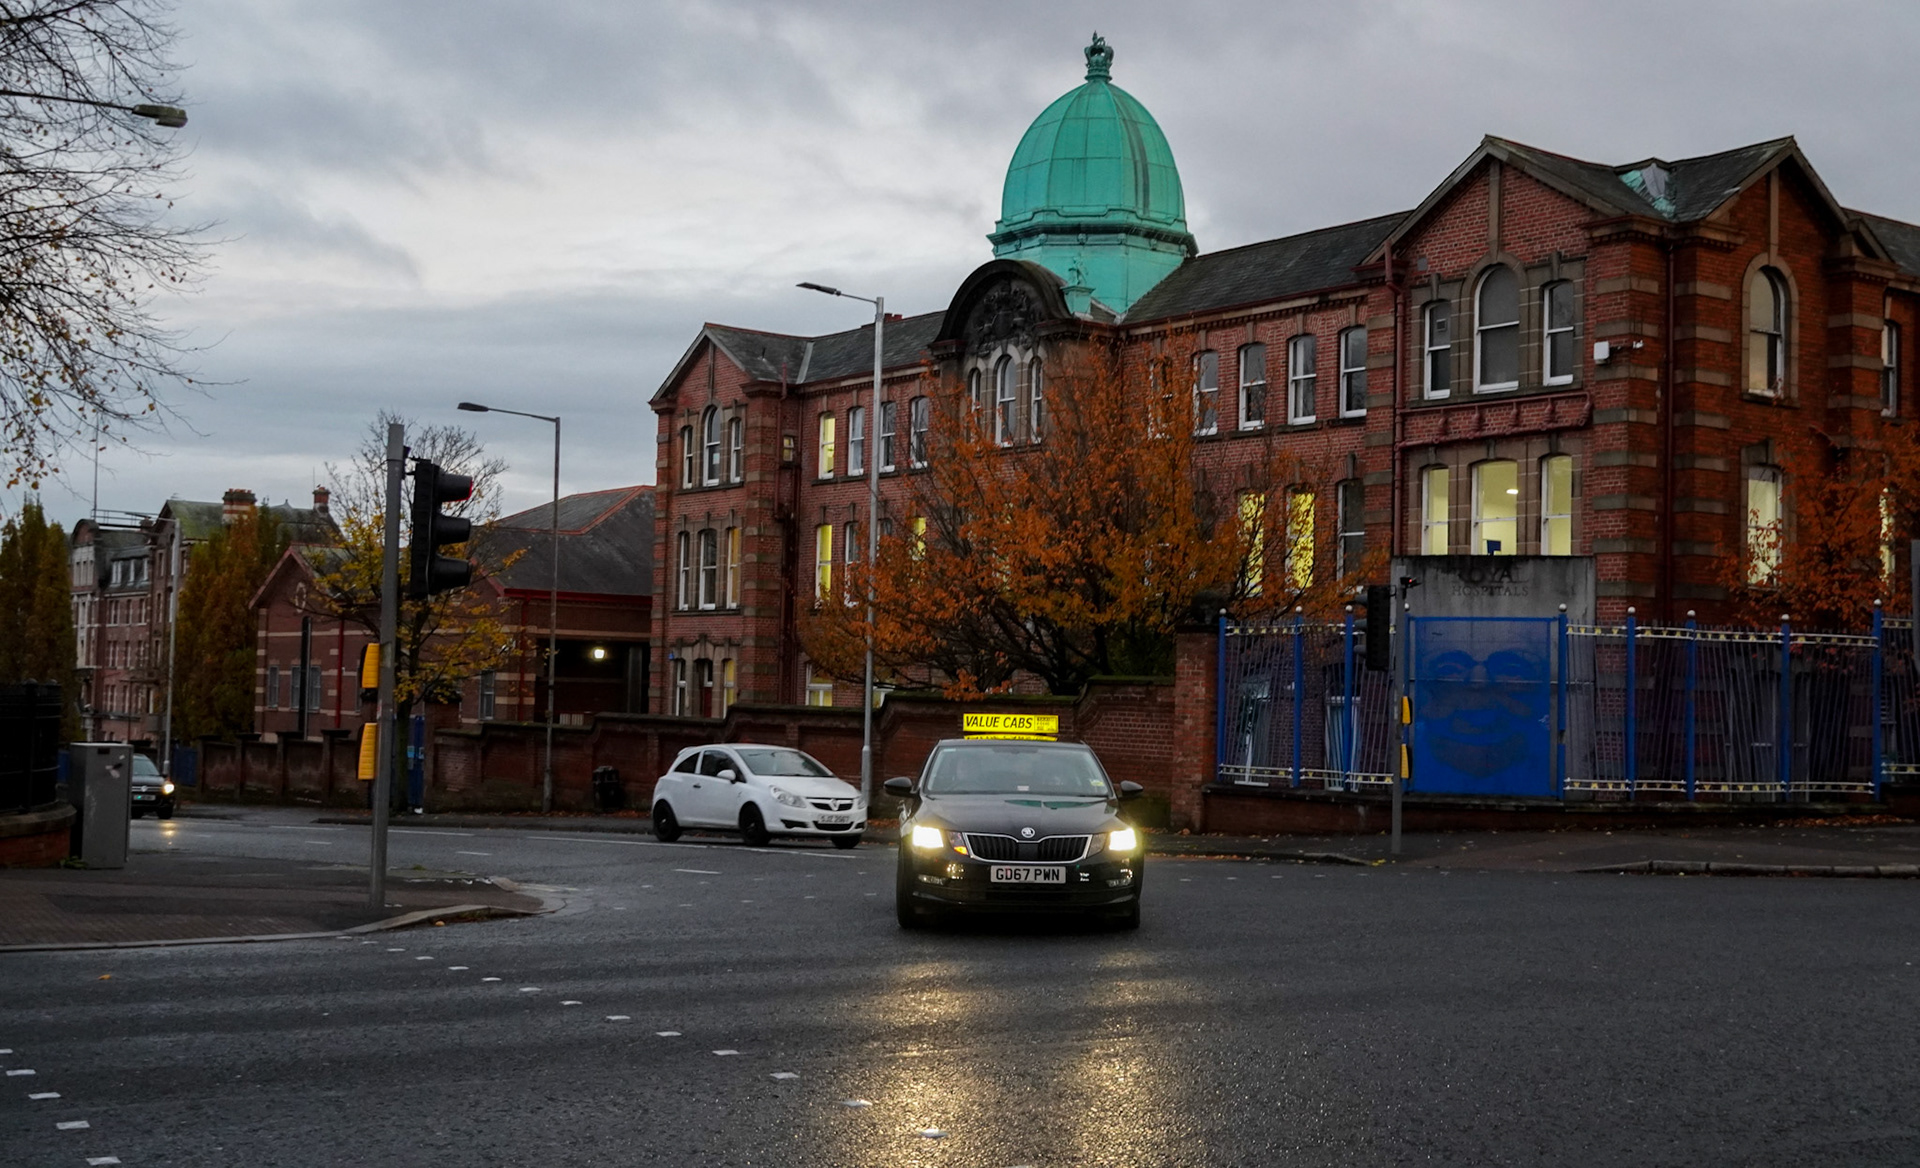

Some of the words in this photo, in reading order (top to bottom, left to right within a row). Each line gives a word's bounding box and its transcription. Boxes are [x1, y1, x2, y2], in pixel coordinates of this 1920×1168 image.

[1452, 585, 1529, 597] HOSPITALS
[965, 715, 1000, 728] VALUE
[1003, 717, 1033, 729] CABS
[995, 868, 1031, 881] GD67
[1034, 868, 1060, 882] PWN
